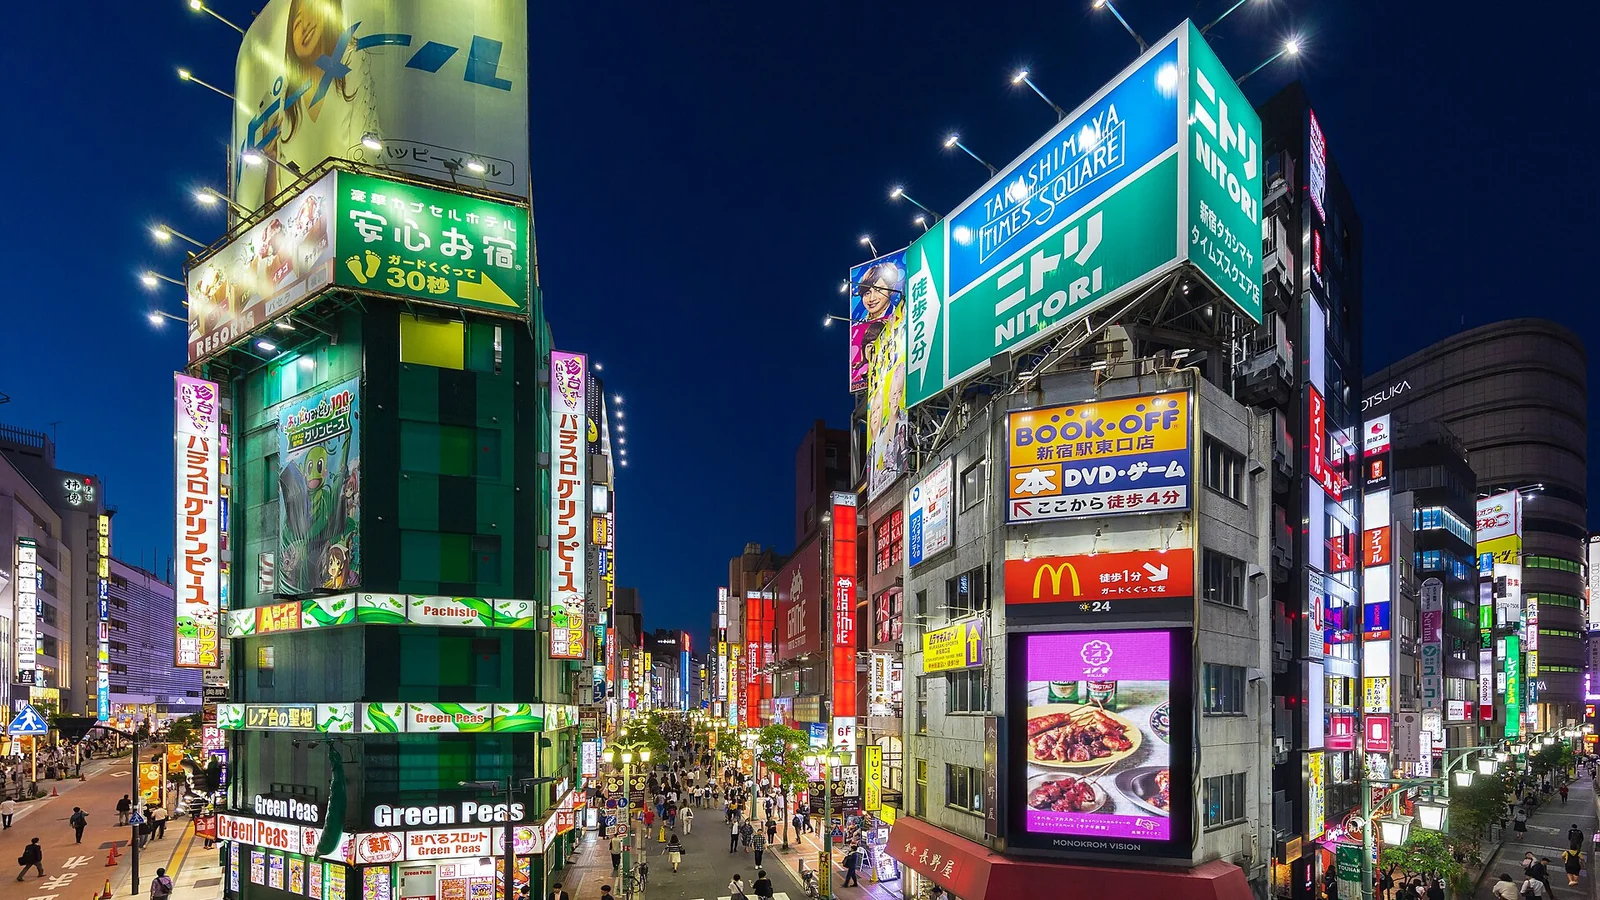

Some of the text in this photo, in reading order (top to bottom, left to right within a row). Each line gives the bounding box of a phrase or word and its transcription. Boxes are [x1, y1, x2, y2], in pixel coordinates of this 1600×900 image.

[1194, 67, 1257, 181] ニトリ
[984, 103, 1119, 222] TAKASHIMAYA
[984, 134, 1120, 246] TIMES SQUARE
[1195, 132, 1258, 225] NITORI
[350, 209, 517, 270] 安心お宿
[1199, 200, 1254, 268] 新宿タカシマヤ
[388, 254, 477, 280] ガードくぐって
[994, 210, 1103, 317] ニトリ
[1191, 224, 1260, 307] タイムズスクエア店
[386, 267, 450, 294] 30秒
[911, 277, 928, 364] 徒歩2分
[994, 266, 1103, 347] NITORI
[1036, 434, 1155, 461] 新宿駅東口店
[1014, 467, 1057, 495] 本
[1064, 460, 1186, 488] DVD・ゲーム
[557, 413, 582, 593] パチスログリンピース
[1037, 489, 1180, 515] ここから徒歩4分
[184, 435, 213, 605] パチスログリンピース
[1371, 529, 1383, 563] アイフル
[1099, 569, 1142, 583] 徒歩1分
[1101, 584, 1166, 596] ガードくぐって左
[258, 606, 275, 632] A
[423, 604, 478, 619] Pachislo
[840, 588, 853, 644] GAME
[1091, 600, 1112, 612] 24
[1423, 611, 1434, 643] Serina
[1482, 677, 1490, 702] docomo
[249, 707, 313, 728] レア台の聖地
[415, 712, 484, 724] Green Peas
[837, 726, 852, 737] 6F
[254, 794, 319, 822] Green Peas
[373, 801, 525, 827] Green Peas
[218, 815, 253, 842] Green
[257, 820, 289, 849] Peas
[367, 835, 391, 853] 新
[410, 831, 488, 846] 選べるスロット
[1053, 839, 1141, 851] MONOKROM VISION
[417, 844, 481, 856] Green Peas
[918, 848, 955, 880] 長野屋
